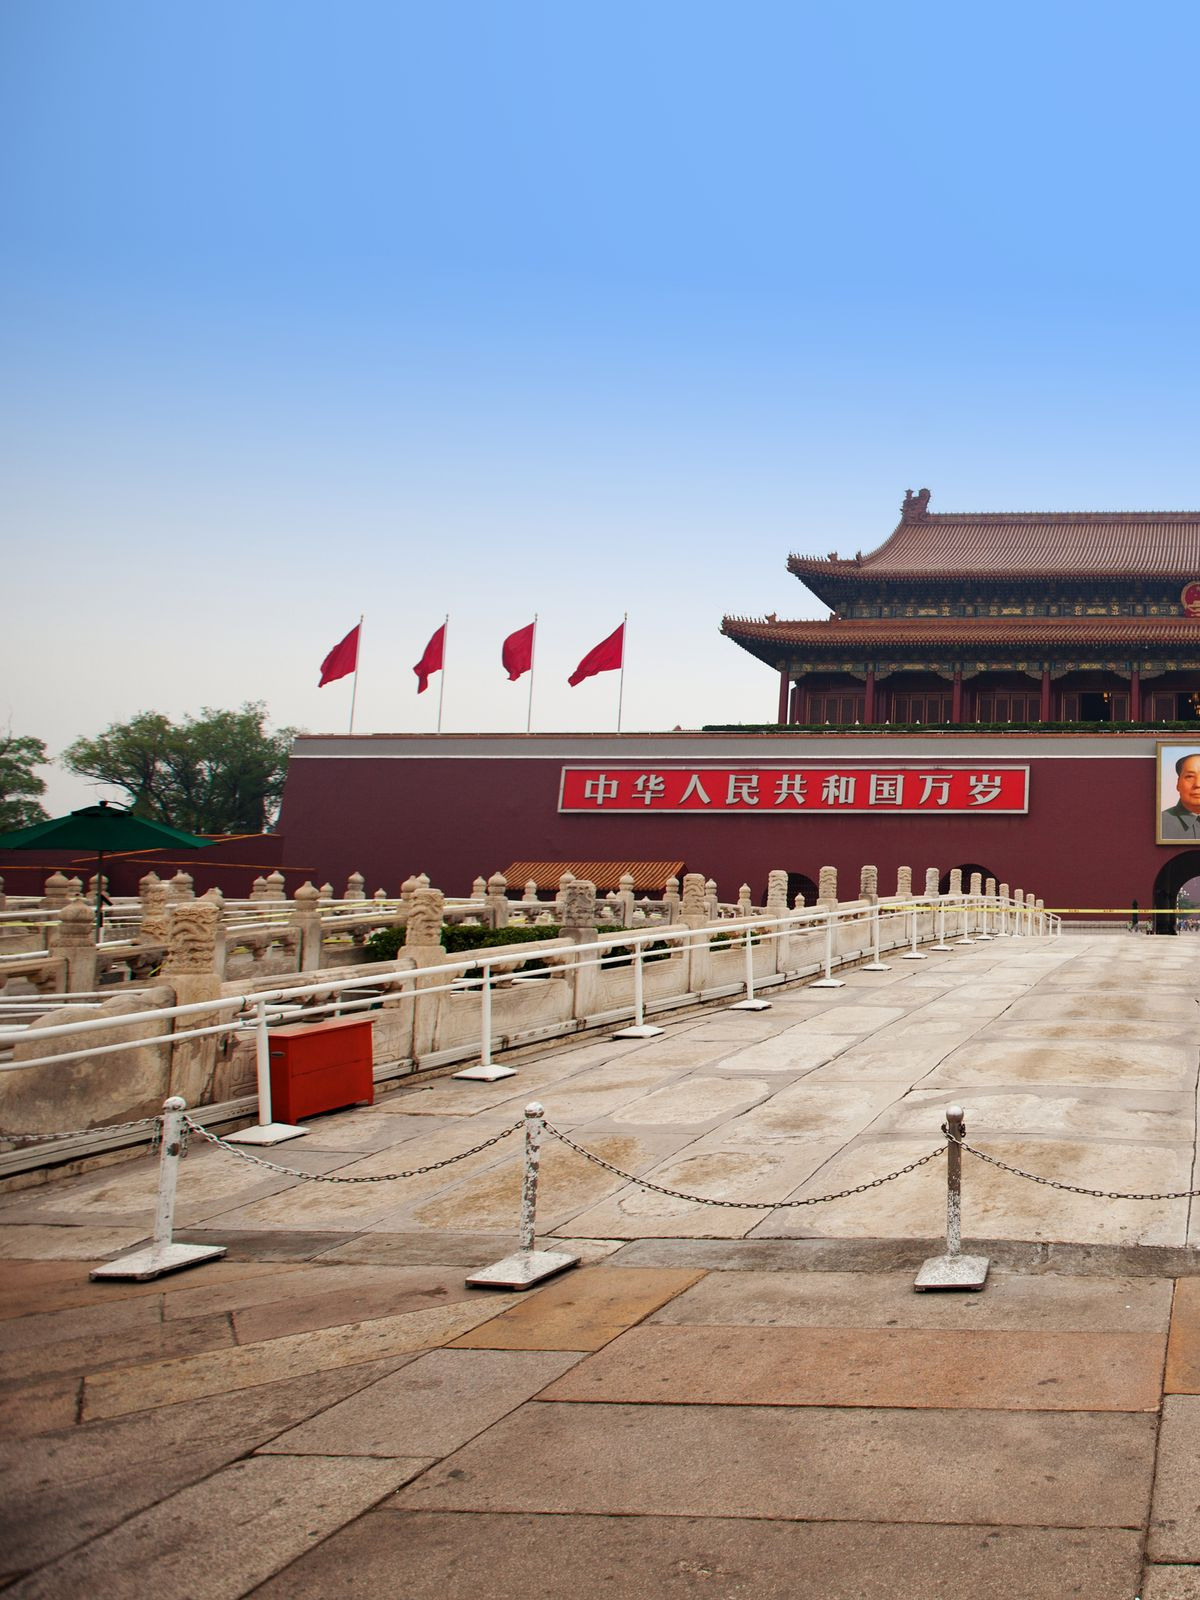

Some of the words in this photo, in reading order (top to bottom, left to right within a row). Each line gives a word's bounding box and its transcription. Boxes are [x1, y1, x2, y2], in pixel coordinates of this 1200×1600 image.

[584, 774, 1002, 805] 中华人民共和国万岁
